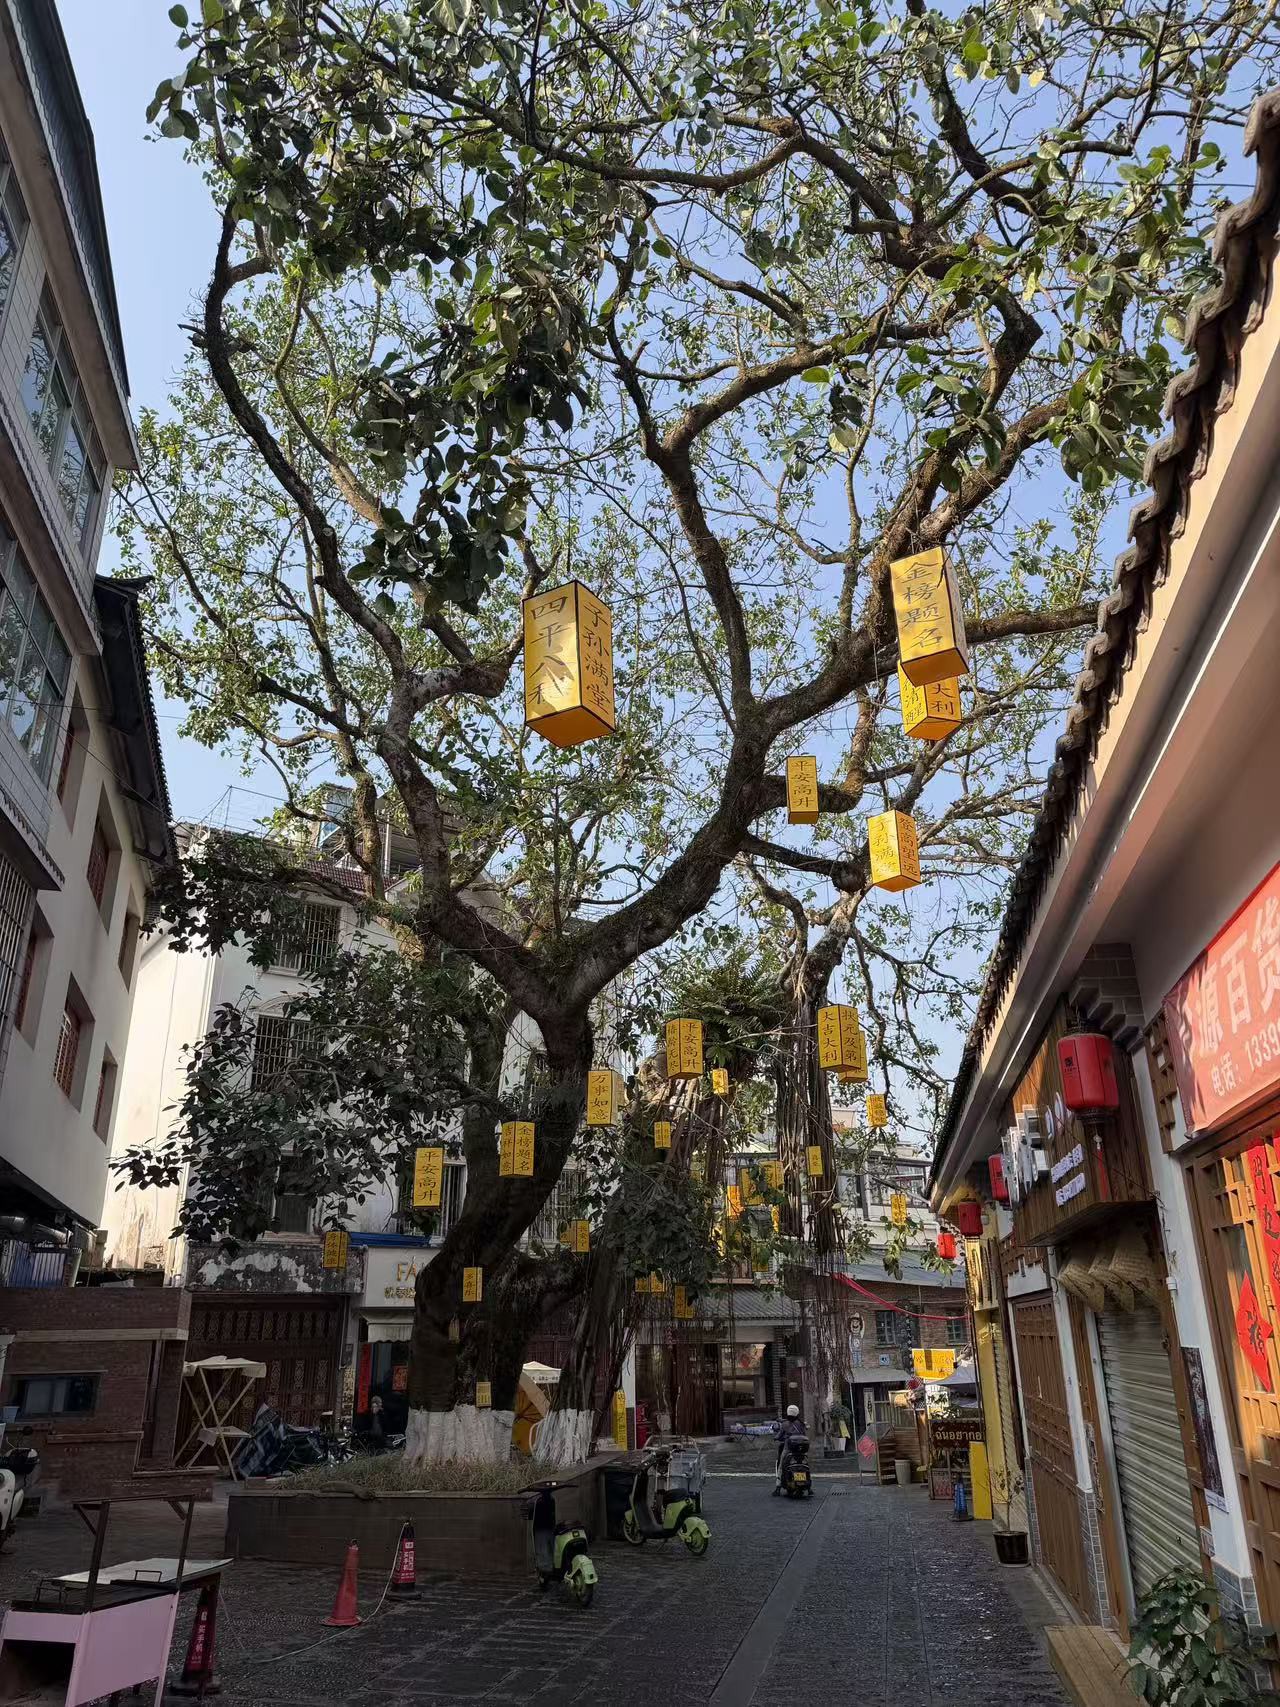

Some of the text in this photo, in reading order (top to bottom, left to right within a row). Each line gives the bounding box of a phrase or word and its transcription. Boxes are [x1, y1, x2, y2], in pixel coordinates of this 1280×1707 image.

[896, 561, 945, 650] 金榜题名
[582, 601, 611, 715] 子孙满堂
[790, 760, 815, 808] 平安高升
[900, 817, 919, 876] 登高望远
[682, 1022, 700, 1069] 平安高升
[823, 1011, 838, 1062] 大吉大利
[842, 1009, 858, 1062] 状元及第
[590, 1074, 609, 1120] 万事如意
[502, 1125, 514, 1172] 吉祥如意
[516, 1125, 532, 1171] 金榜题名
[416, 1151, 439, 1201] 平安高升
